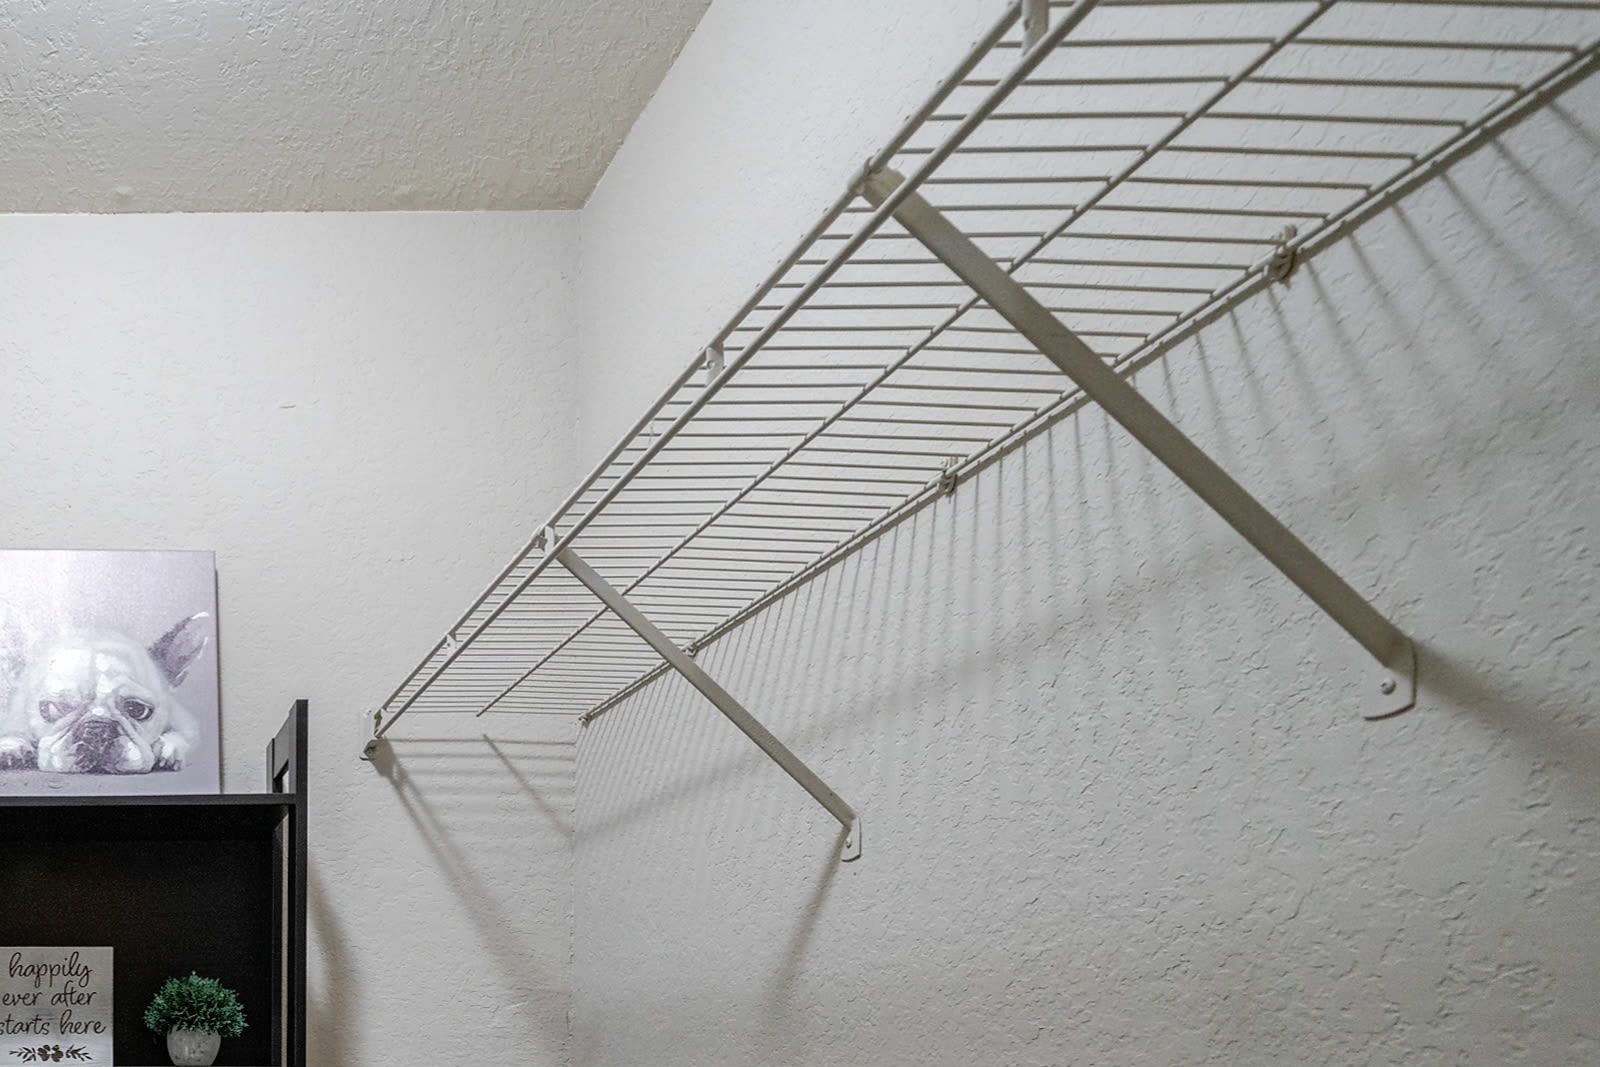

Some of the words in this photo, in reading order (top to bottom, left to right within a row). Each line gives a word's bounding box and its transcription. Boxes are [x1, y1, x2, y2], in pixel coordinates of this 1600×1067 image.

[9, 951, 93, 988] happily
[2, 992, 43, 1006] ever
[51, 980, 96, 1007] after
[60, 1009, 106, 1034] here
